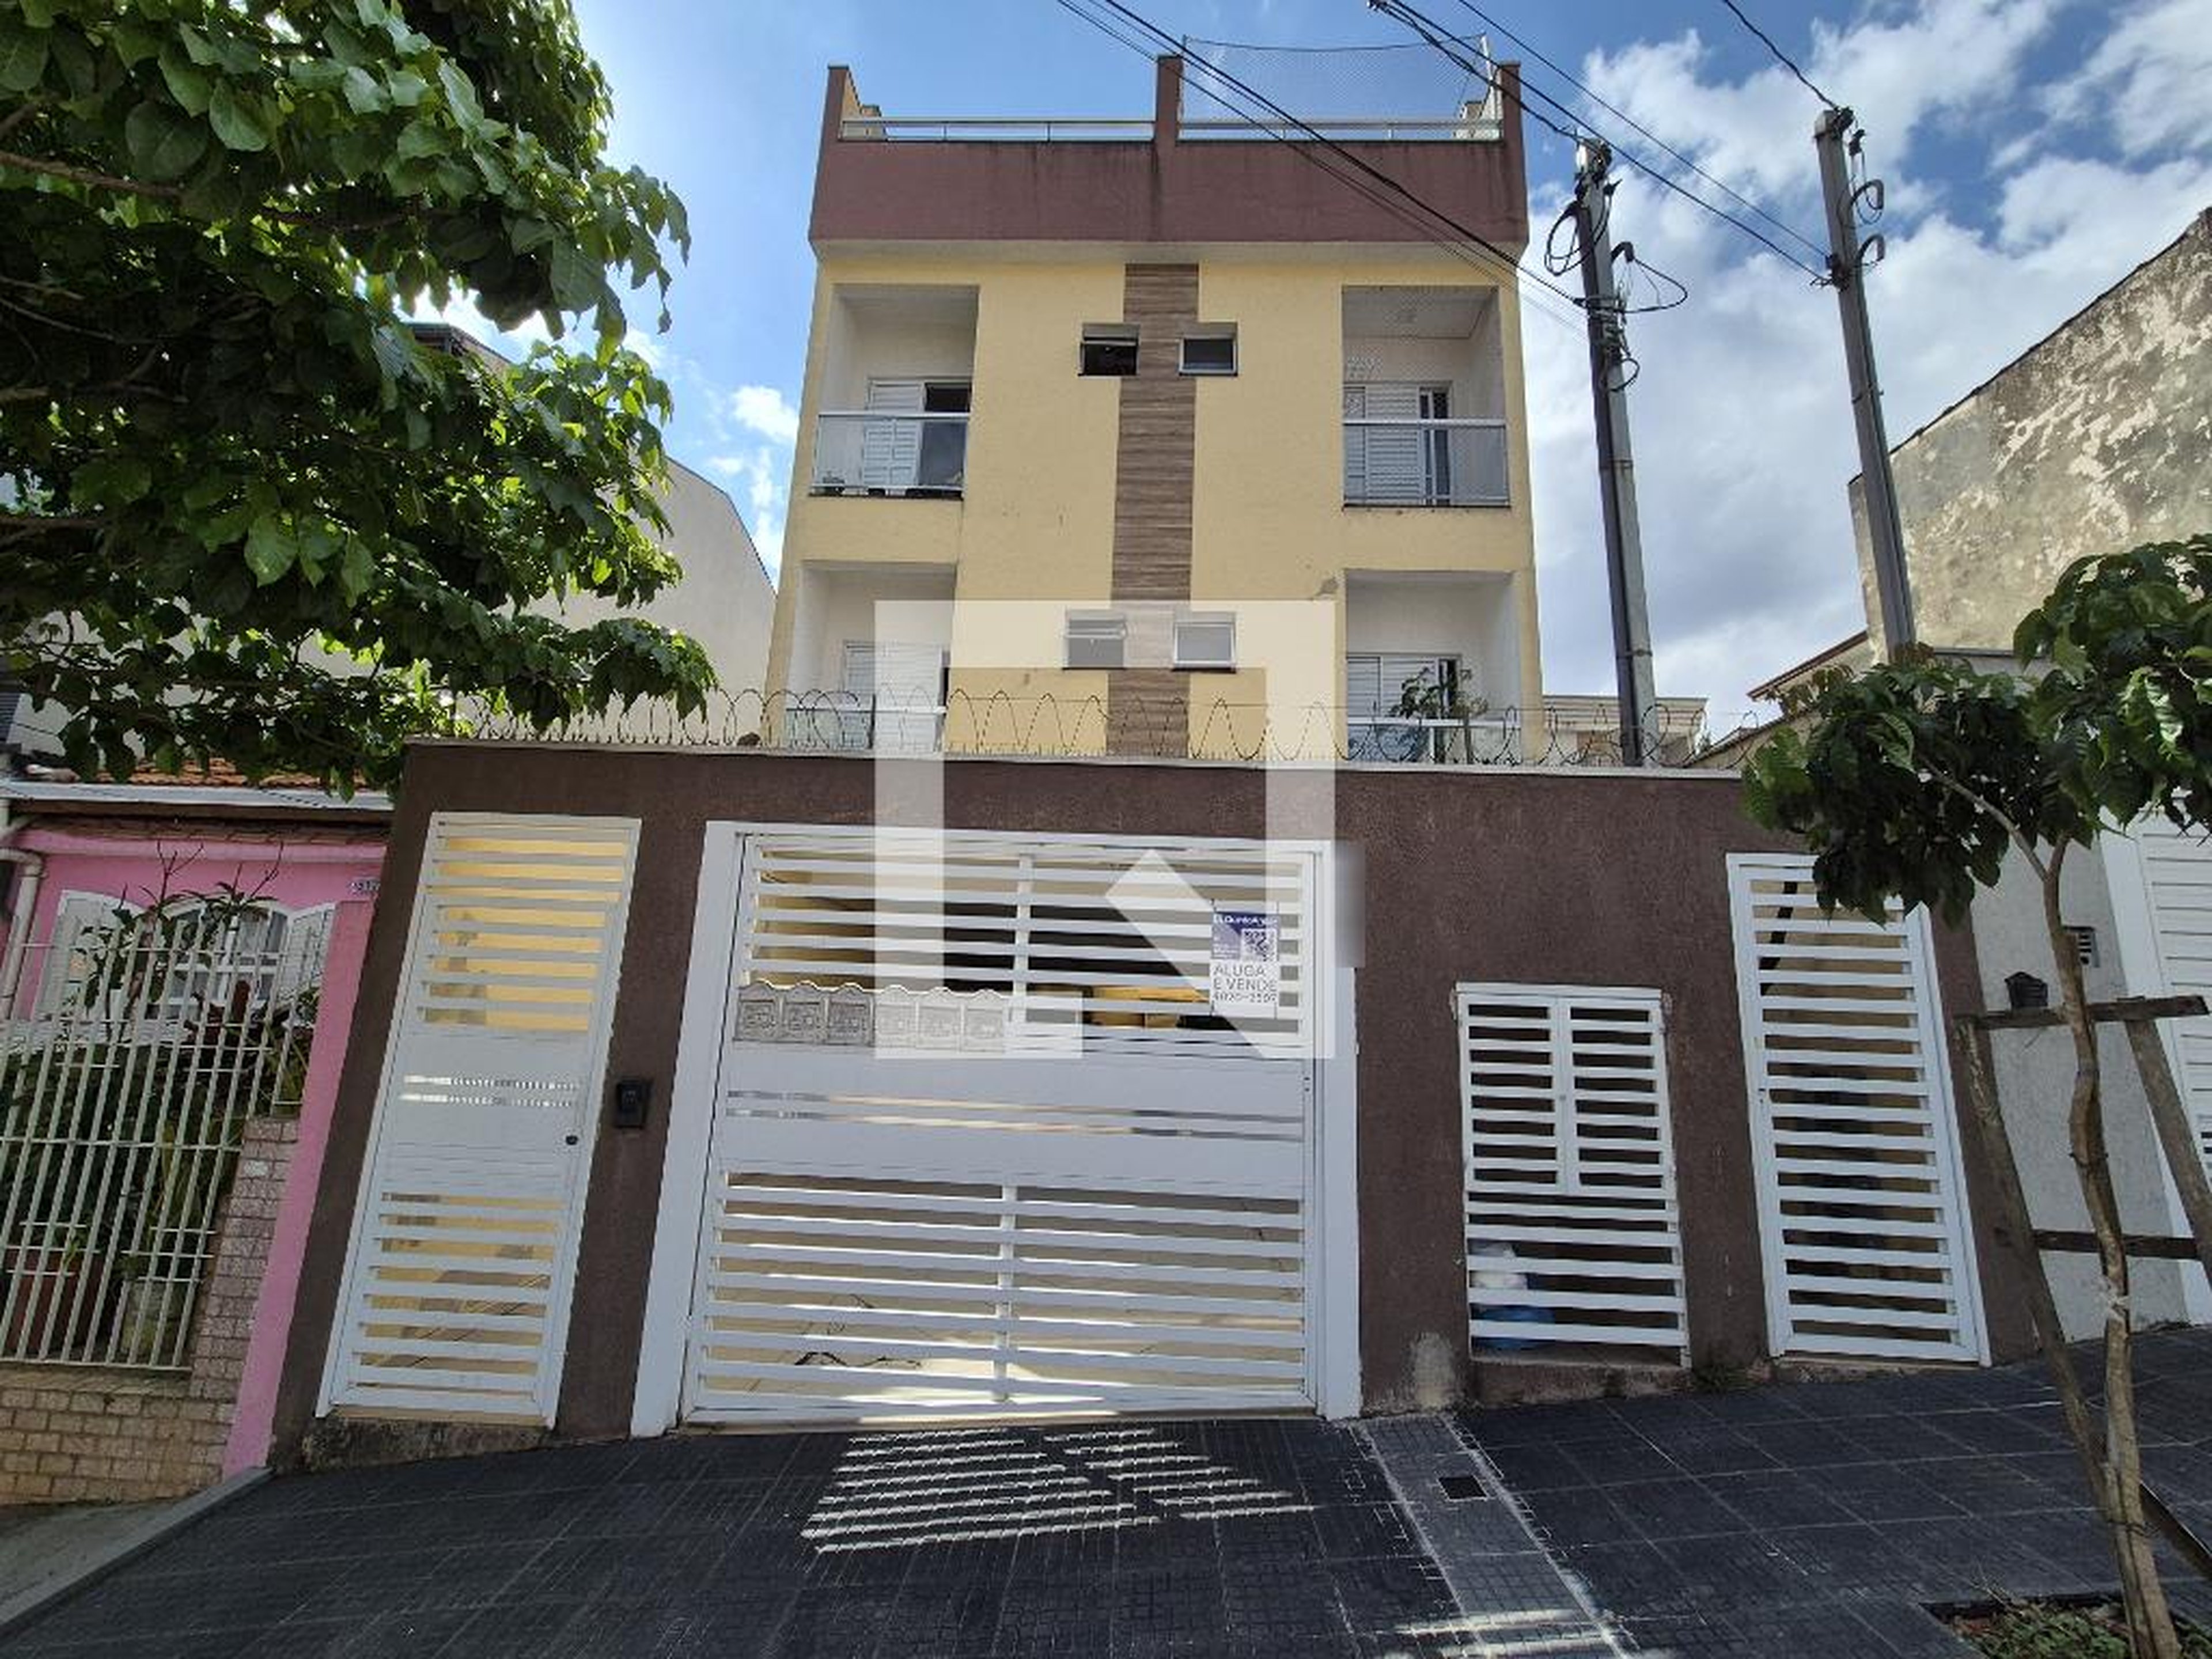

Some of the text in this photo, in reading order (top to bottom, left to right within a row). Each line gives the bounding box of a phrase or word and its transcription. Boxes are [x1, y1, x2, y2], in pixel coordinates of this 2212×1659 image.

[1213, 964, 1266, 977] ALUGA
[1214, 978, 1277, 992] E VENDE
